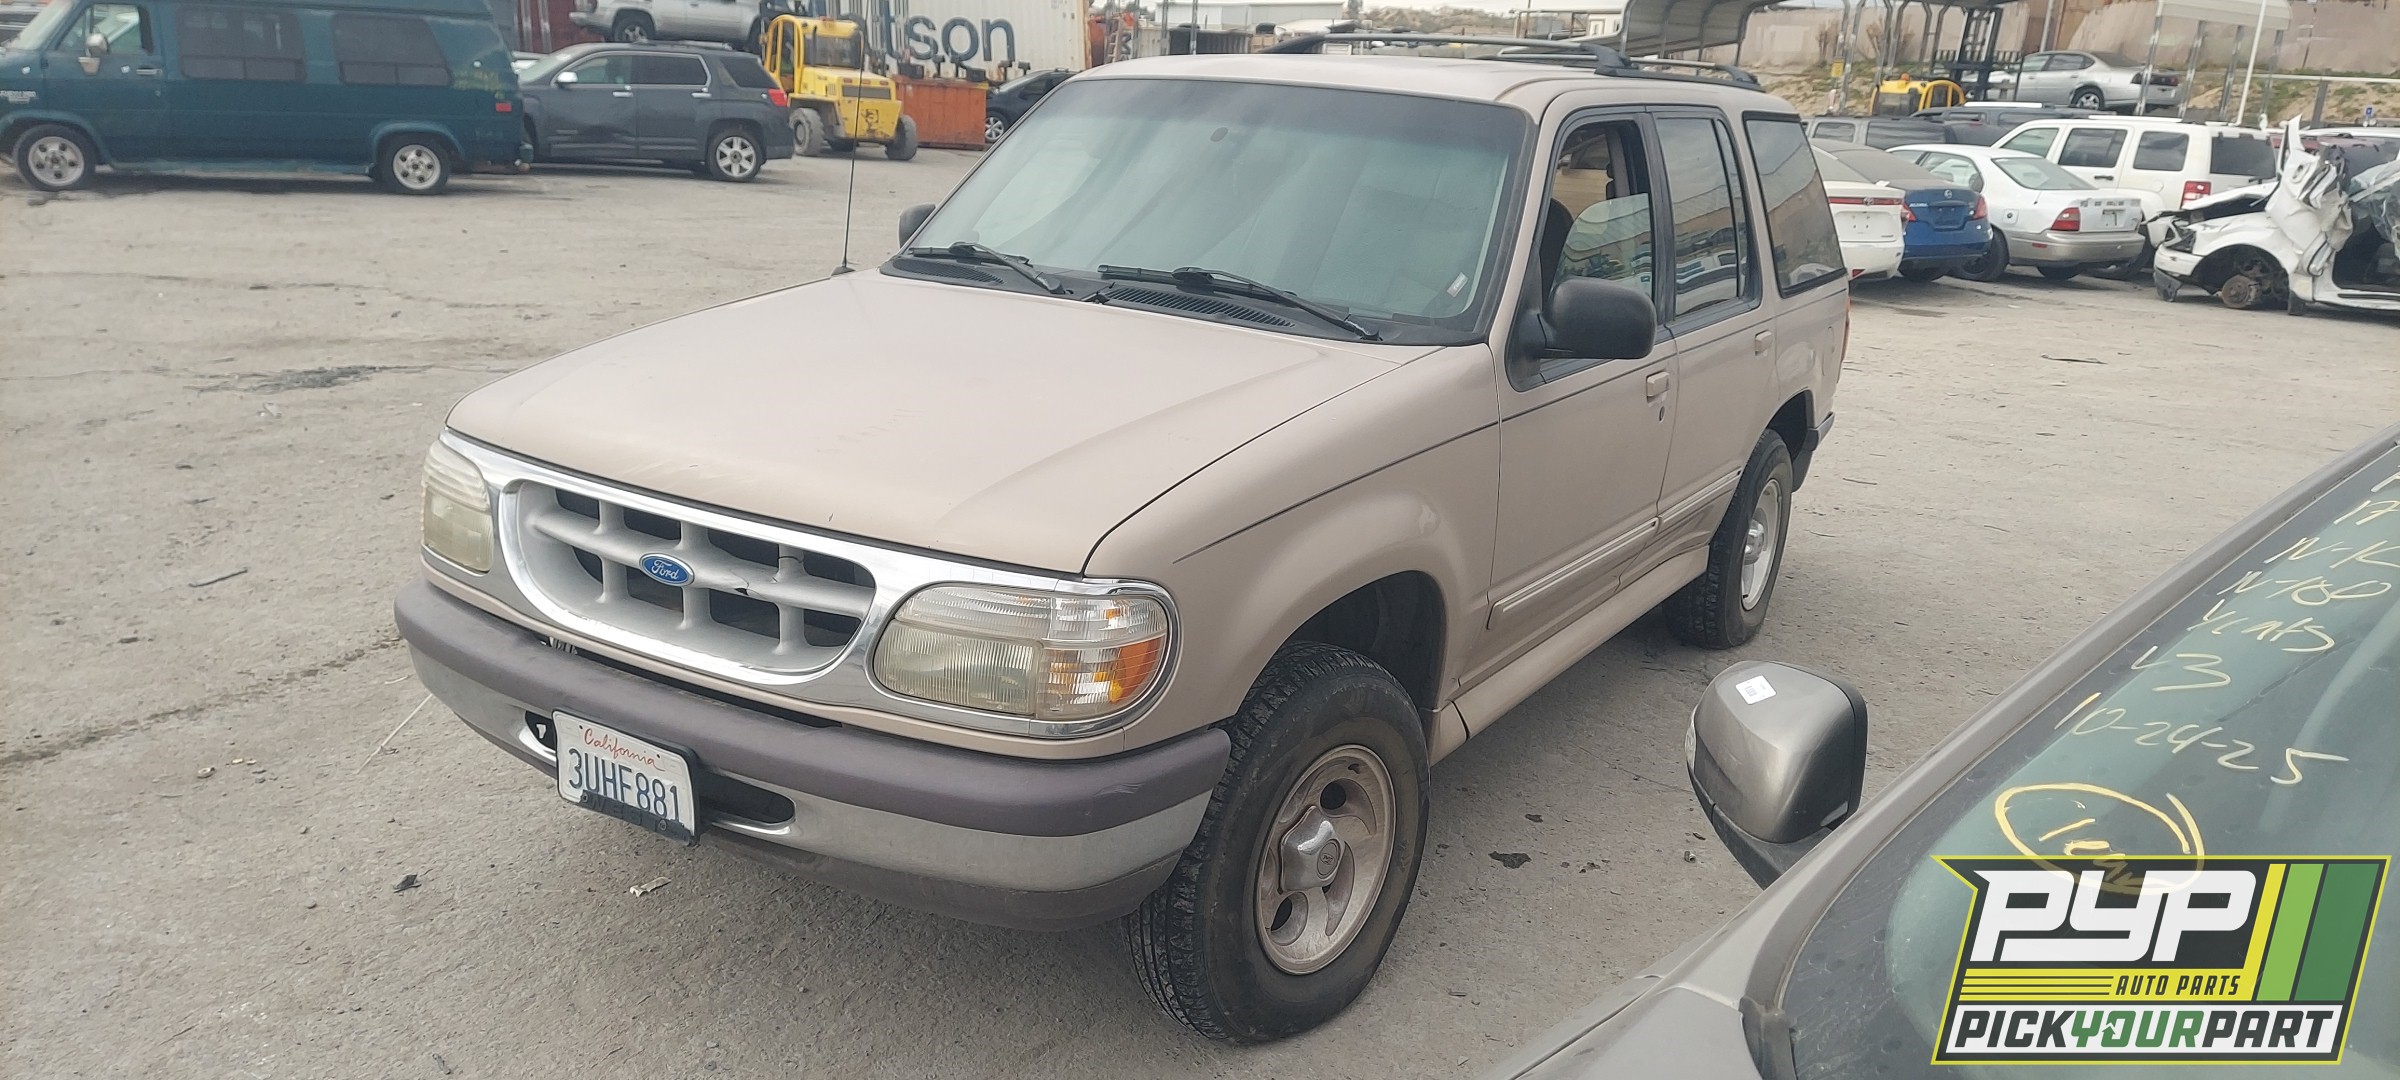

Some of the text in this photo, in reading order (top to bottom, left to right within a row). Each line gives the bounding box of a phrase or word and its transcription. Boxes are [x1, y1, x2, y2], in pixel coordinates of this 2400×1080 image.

[806, 0, 1015, 62] tson
[651, 559, 679, 580] Ford
[584, 727, 665, 772] California
[2053, 692, 2350, 785] 10-24-25
[568, 748, 681, 822] 3UHF881
